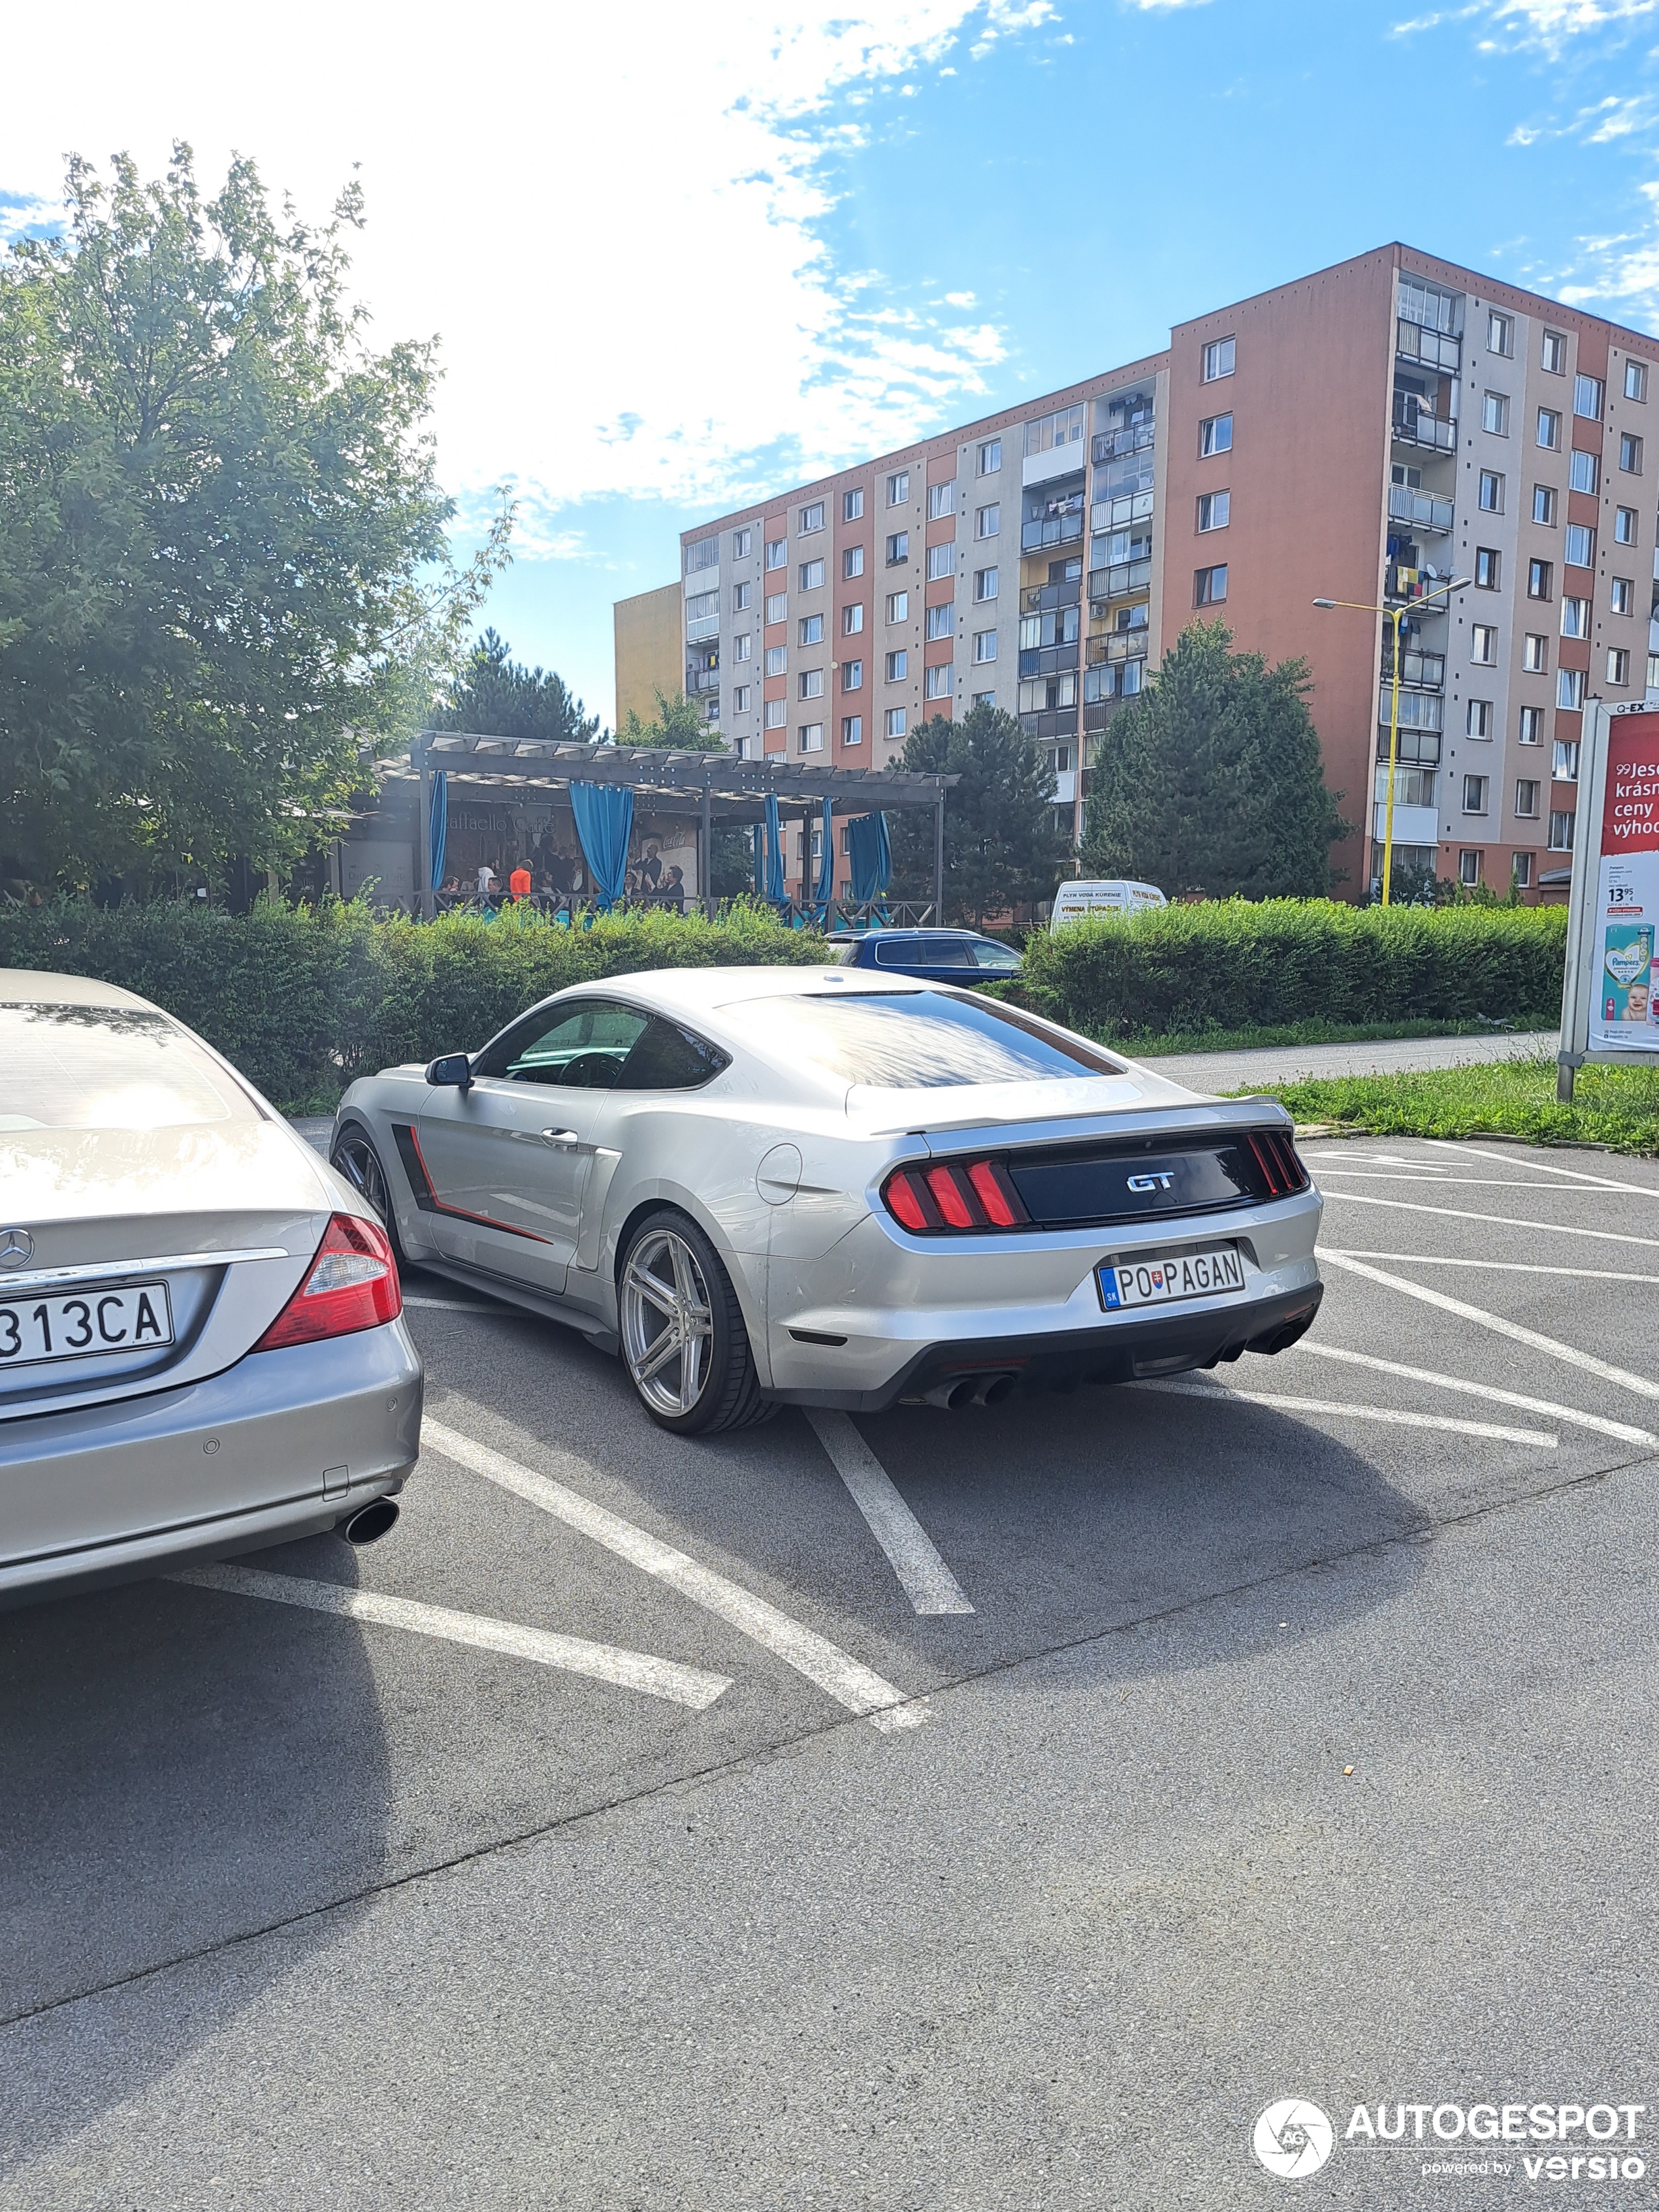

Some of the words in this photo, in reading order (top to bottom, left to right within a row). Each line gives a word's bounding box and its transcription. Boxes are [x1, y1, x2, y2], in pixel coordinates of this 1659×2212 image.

[1615, 803, 1654, 818] ceny
[446, 812, 507, 832] affaello
[1612, 957, 1640, 967] Pampers
[1126, 1171, 1175, 1193] GT
[1118, 1267, 1152, 1302] PO
[1163, 1253, 1240, 1294] PAGAN
[1106, 1291, 1118, 1302] SK
[0, 1292, 162, 1357] 313CA
